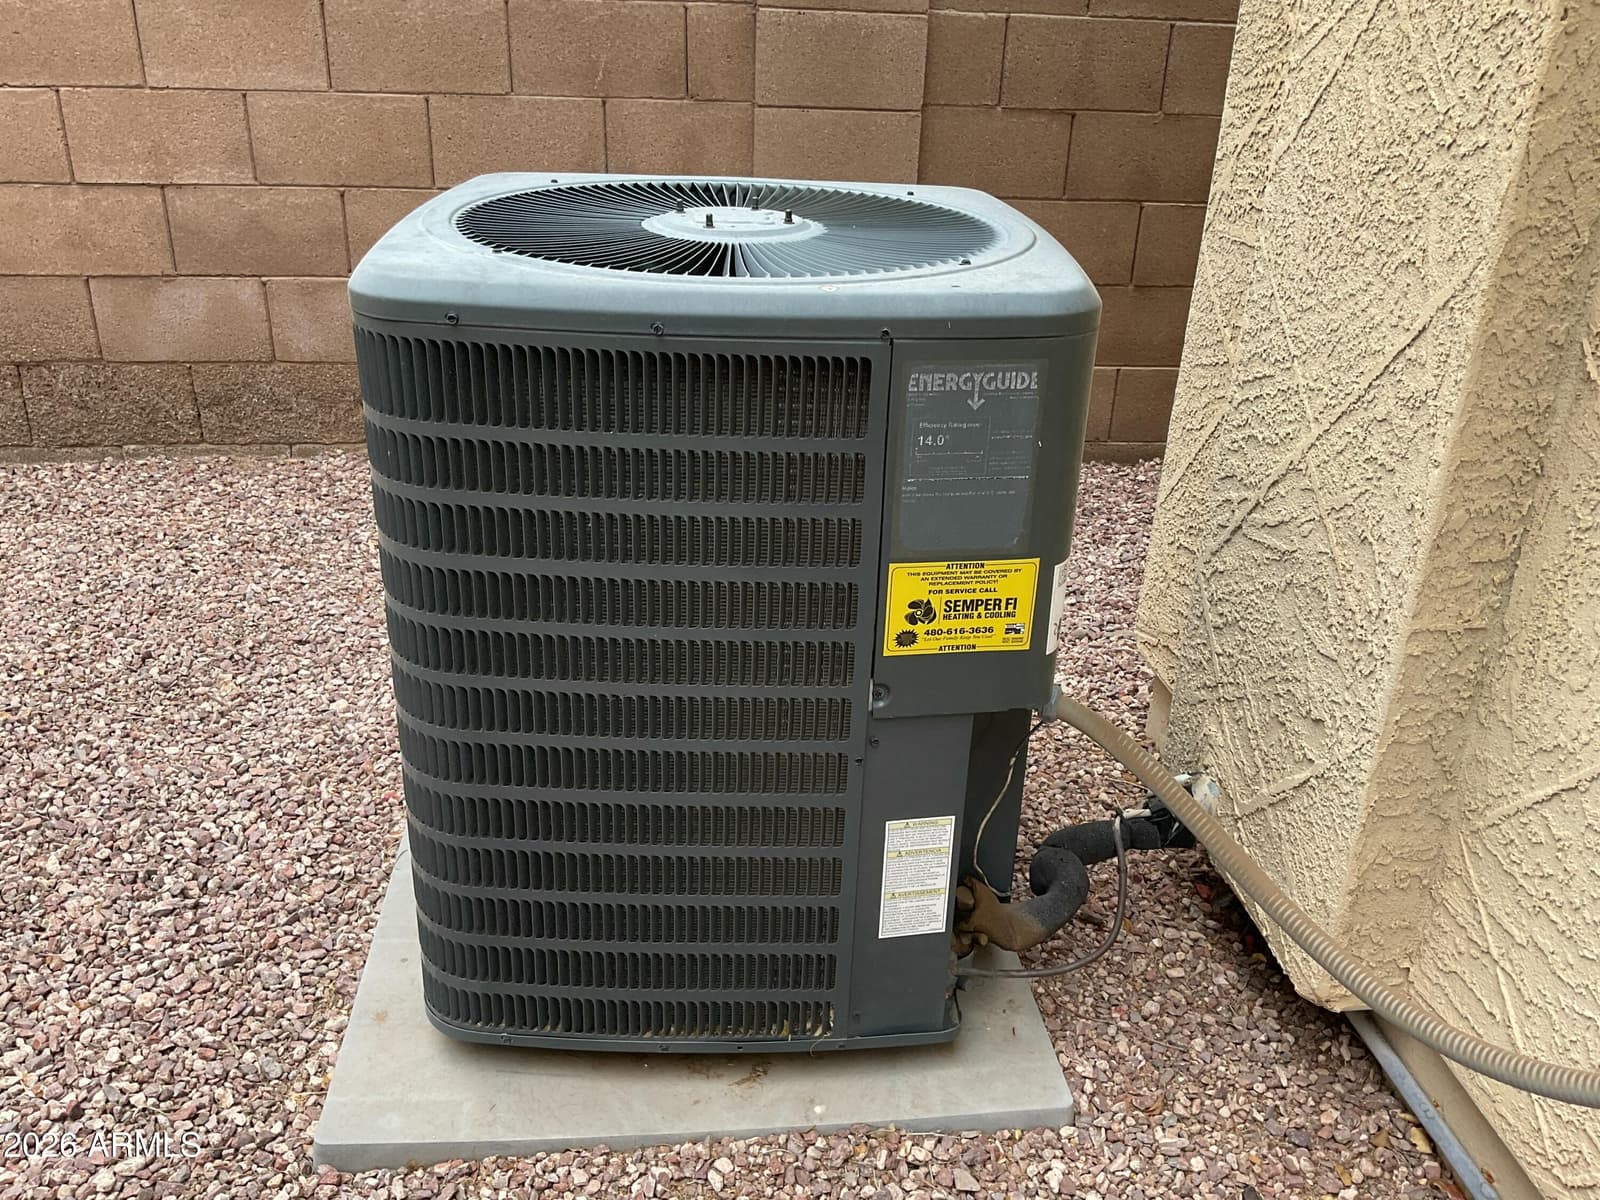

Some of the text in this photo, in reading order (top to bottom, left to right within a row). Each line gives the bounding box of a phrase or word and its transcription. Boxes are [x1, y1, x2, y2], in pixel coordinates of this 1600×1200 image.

[945, 562, 985, 570] ATTENTION
[943, 597, 1018, 613] SEMPER FI
[984, 611, 1016, 619] COOLING
[923, 626, 994, 636] 480-616-3636
[938, 643, 977, 651] ATTENTION
